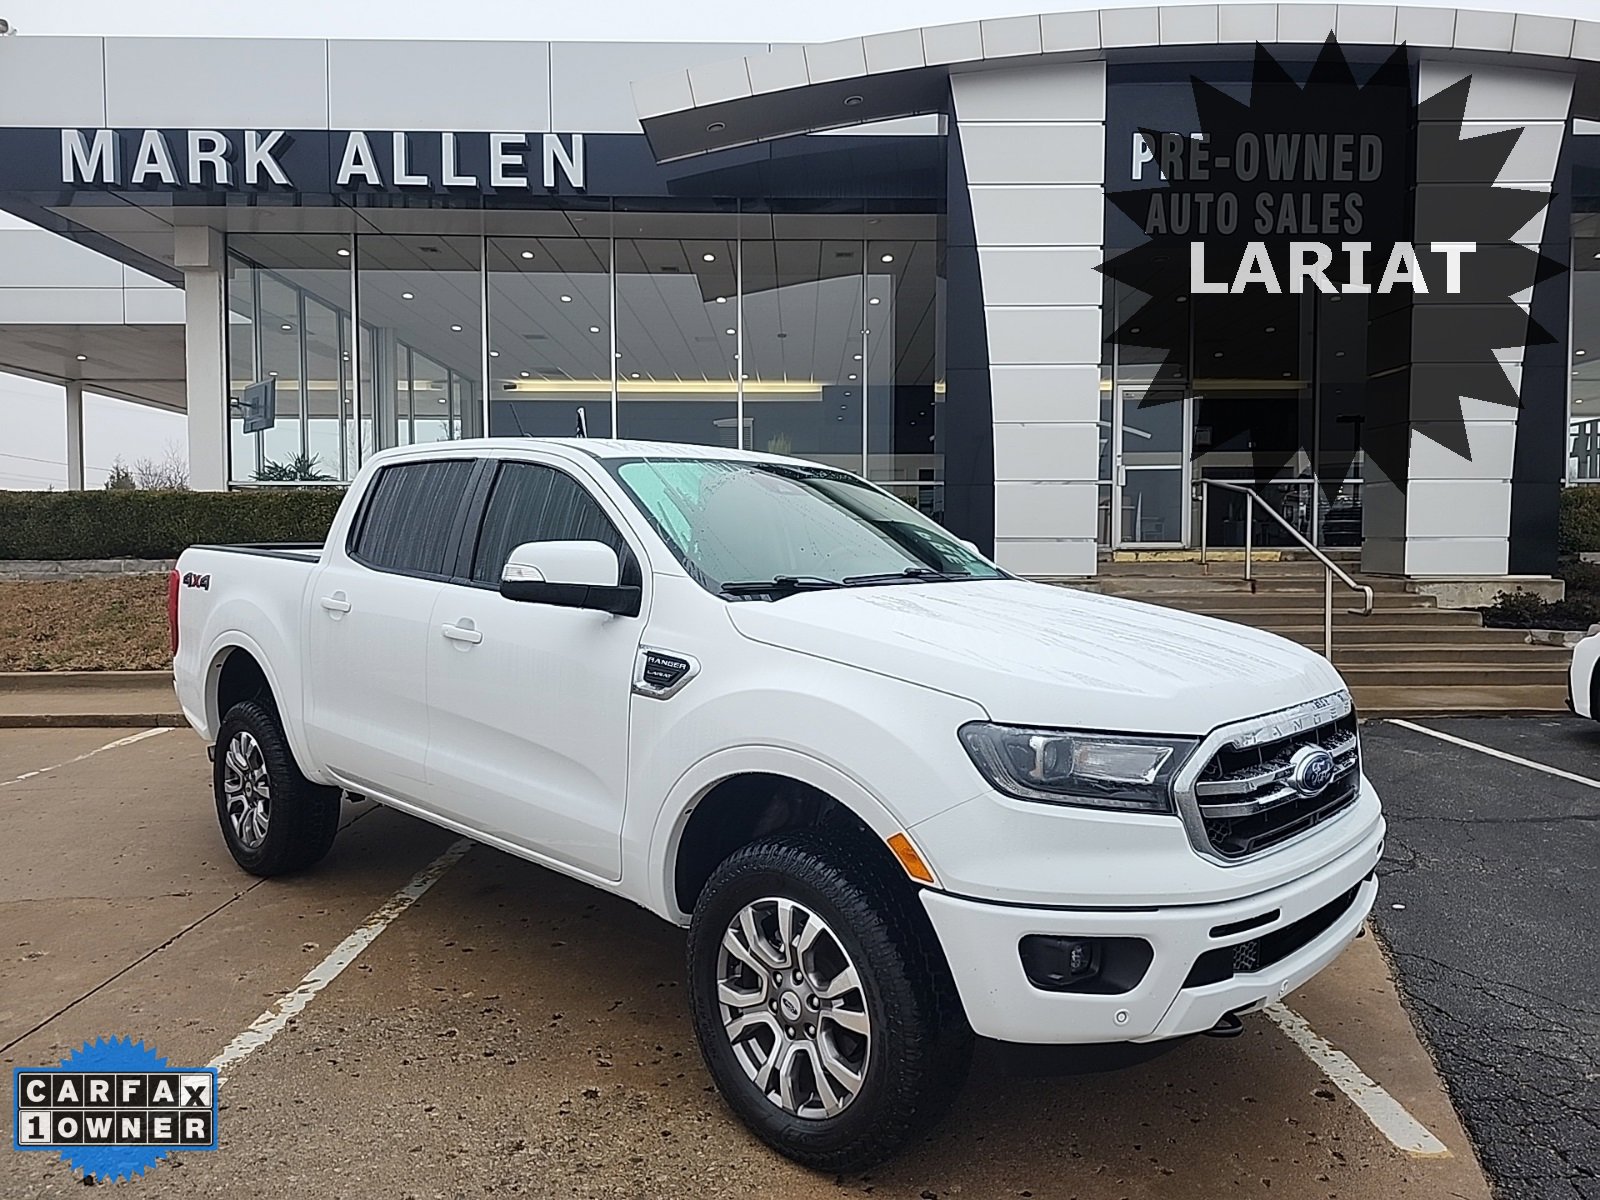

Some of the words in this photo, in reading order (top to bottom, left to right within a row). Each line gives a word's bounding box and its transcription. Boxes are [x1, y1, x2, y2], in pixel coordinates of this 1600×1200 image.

[61, 128, 292, 186] MARK
[336, 131, 587, 190] ALLEN
[1131, 132, 1383, 182] PRE-OWNED
[1145, 192, 1240, 235] AUTO
[1254, 192, 1364, 235] SALES
[647, 656, 687, 670] RANGER
